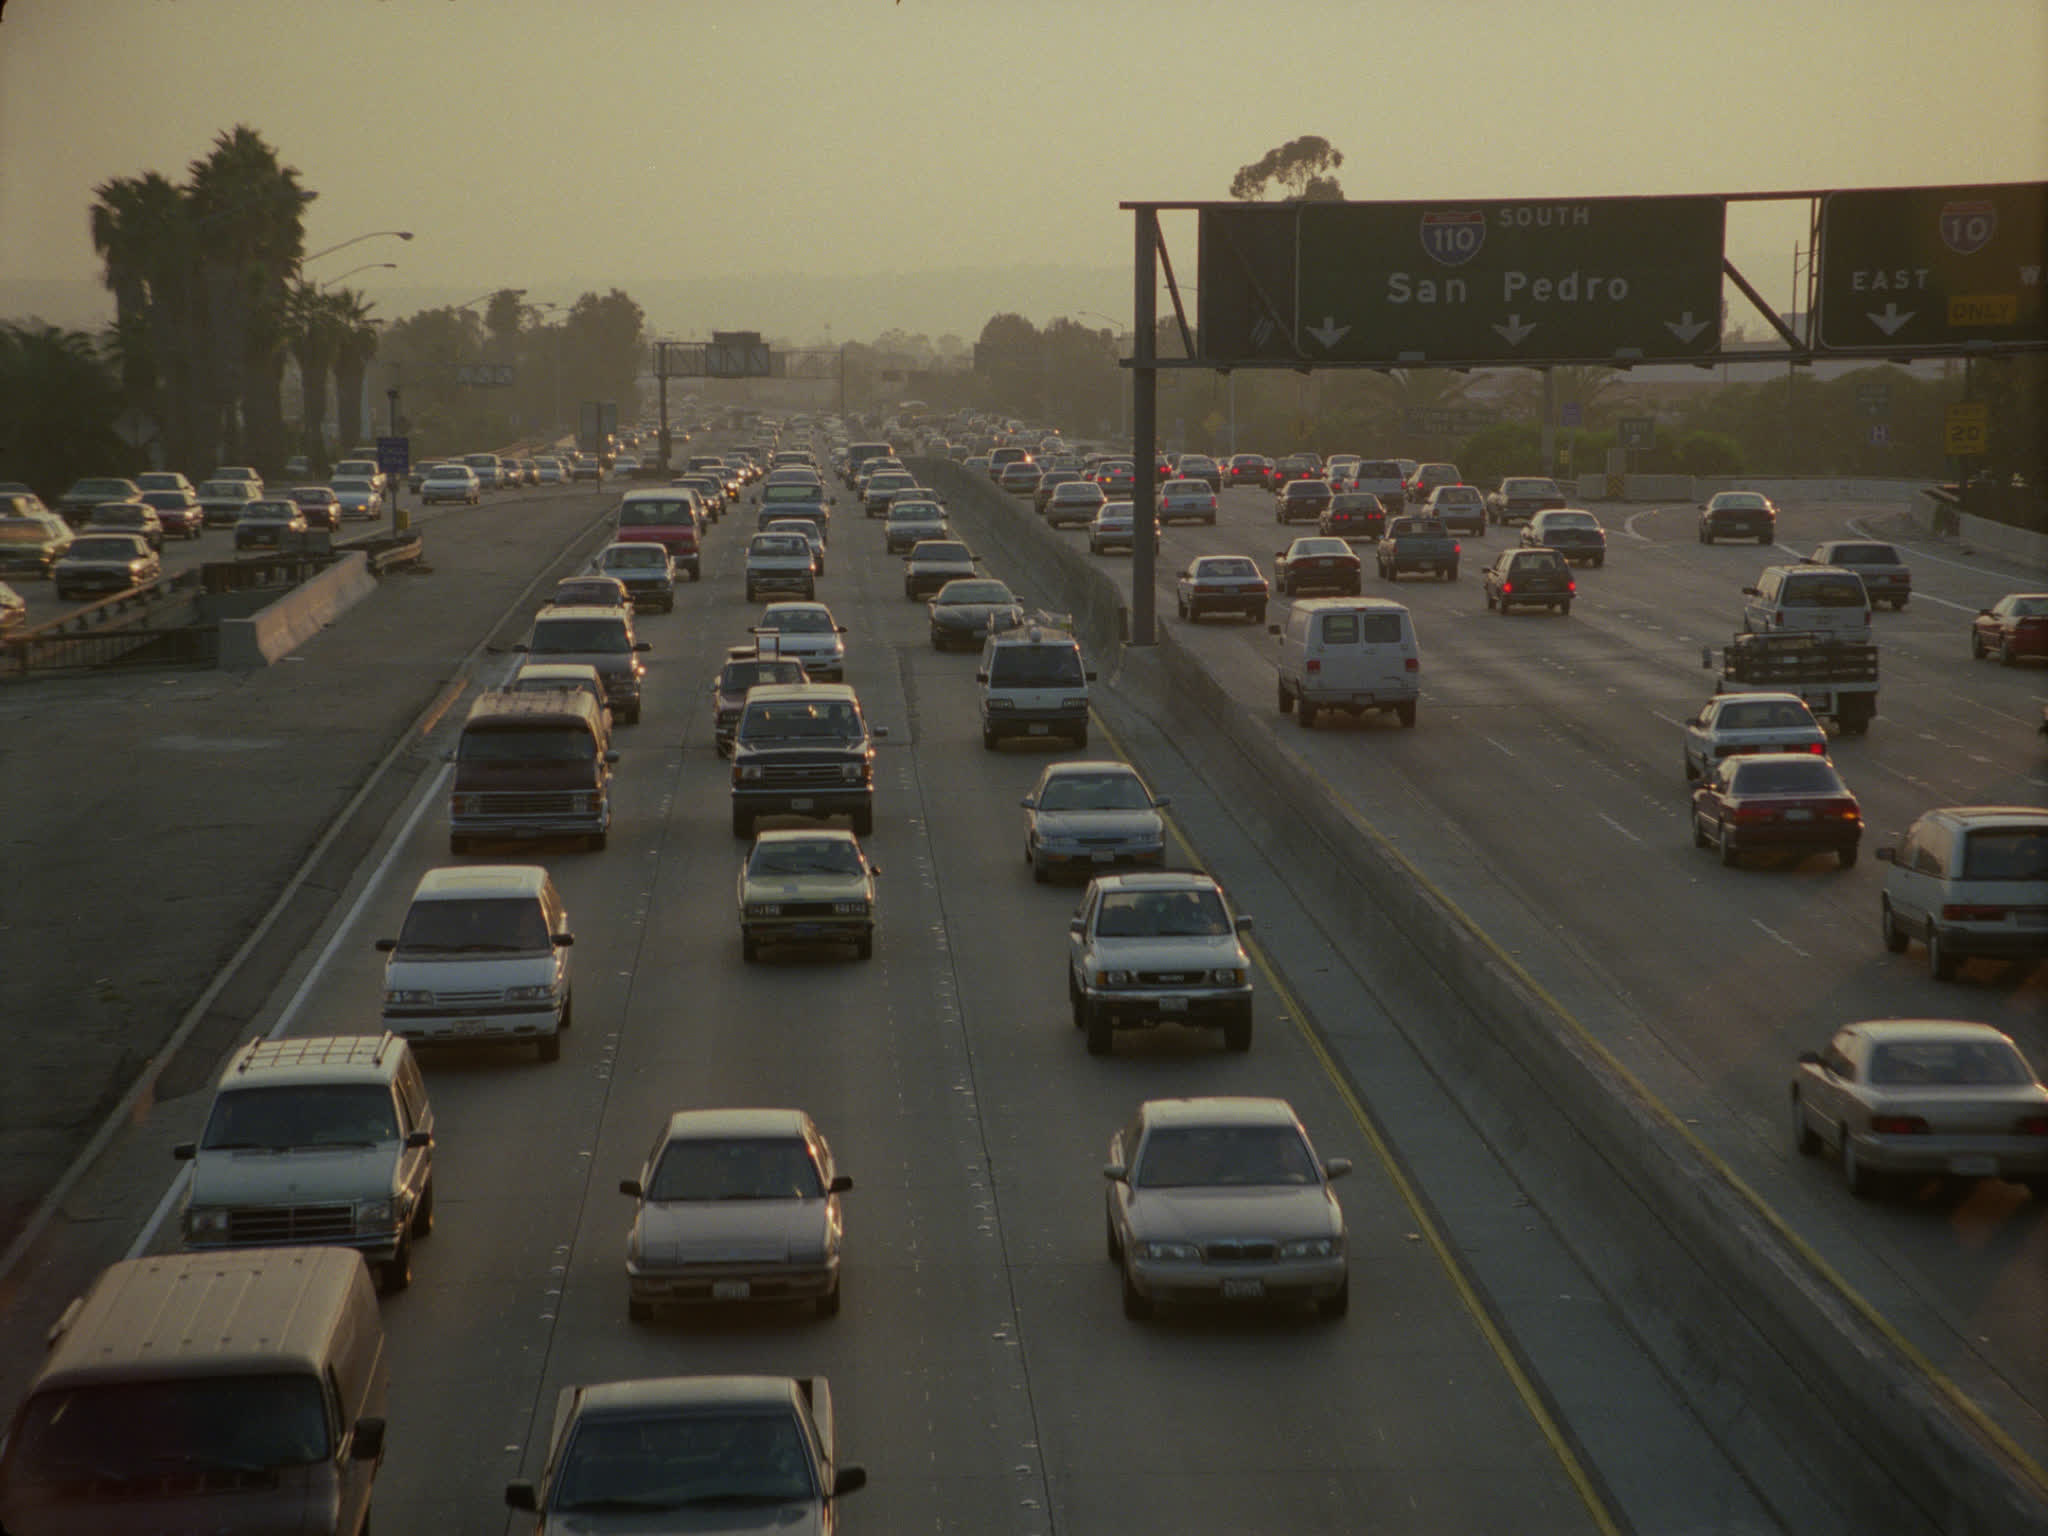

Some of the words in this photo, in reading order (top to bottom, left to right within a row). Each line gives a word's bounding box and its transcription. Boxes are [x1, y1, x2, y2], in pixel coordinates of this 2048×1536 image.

[1500, 206, 1590, 226] SOUTH
[1433, 227, 1474, 251] 110
[1952, 217, 1987, 240] 10
[1387, 272, 1466, 303] San
[1504, 271, 1628, 302] Pedro
[1852, 269, 1929, 291] EAST
[1952, 302, 2010, 321] ONLY
[1951, 425, 1979, 442] 20
